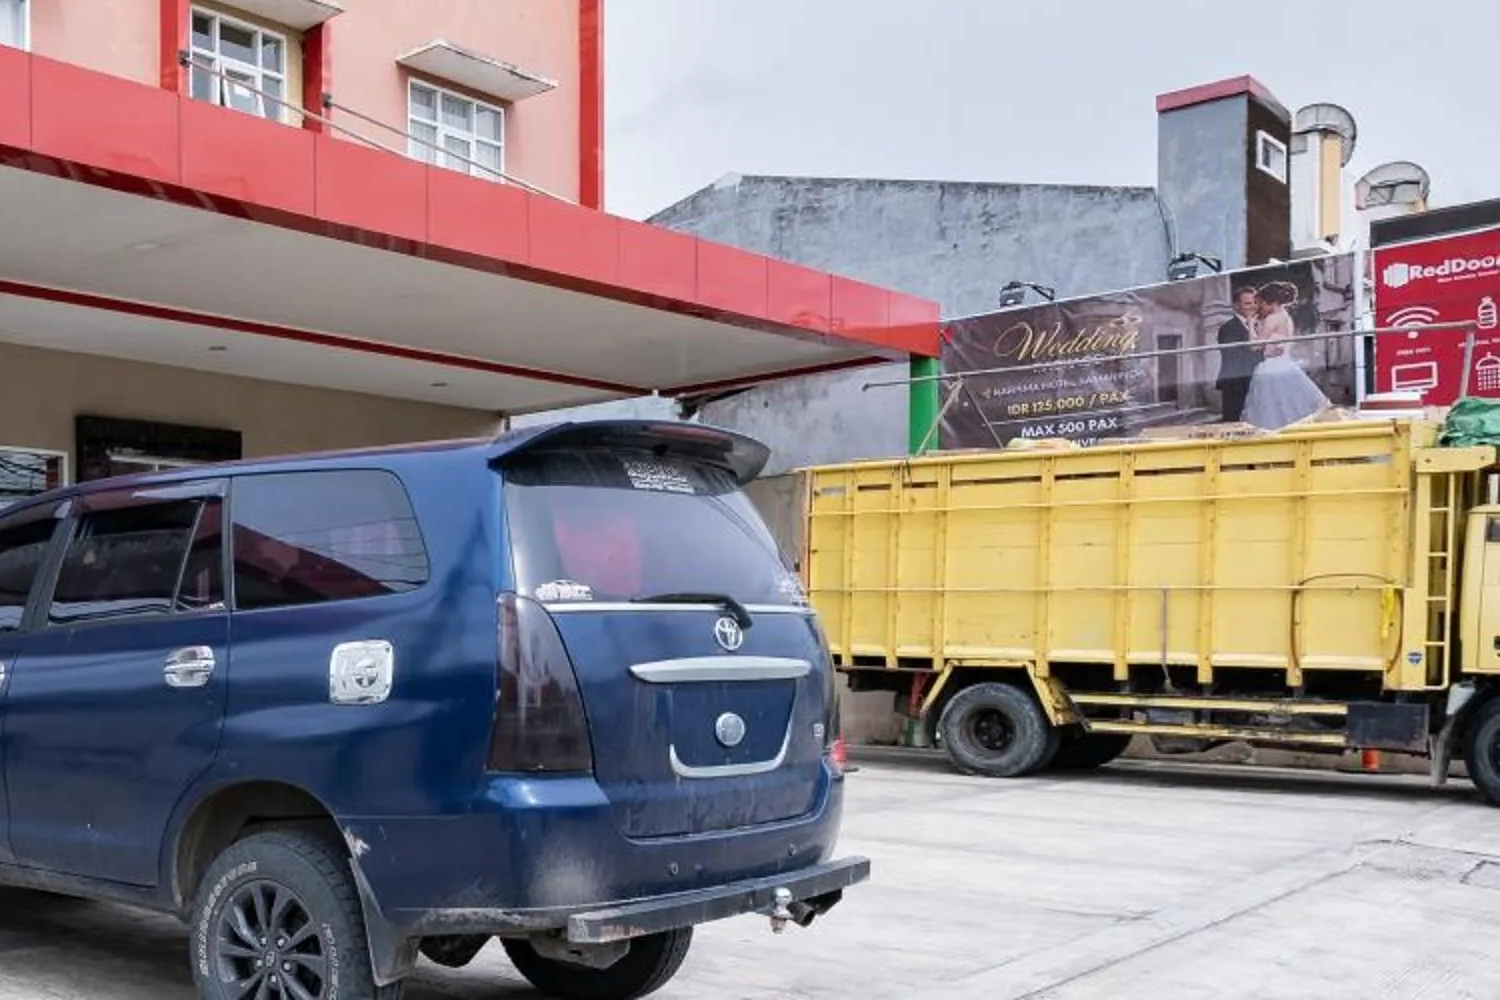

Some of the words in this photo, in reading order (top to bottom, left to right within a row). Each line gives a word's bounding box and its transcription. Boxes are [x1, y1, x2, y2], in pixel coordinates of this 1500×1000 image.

[995, 321, 1139, 360] Wedding
[1007, 403, 1029, 415] IDR
[1100, 391, 1127, 404] PAX
[1021, 425, 1055, 438] MAX
[1058, 421, 1085, 433] 500
[1089, 416, 1118, 431] PAX
